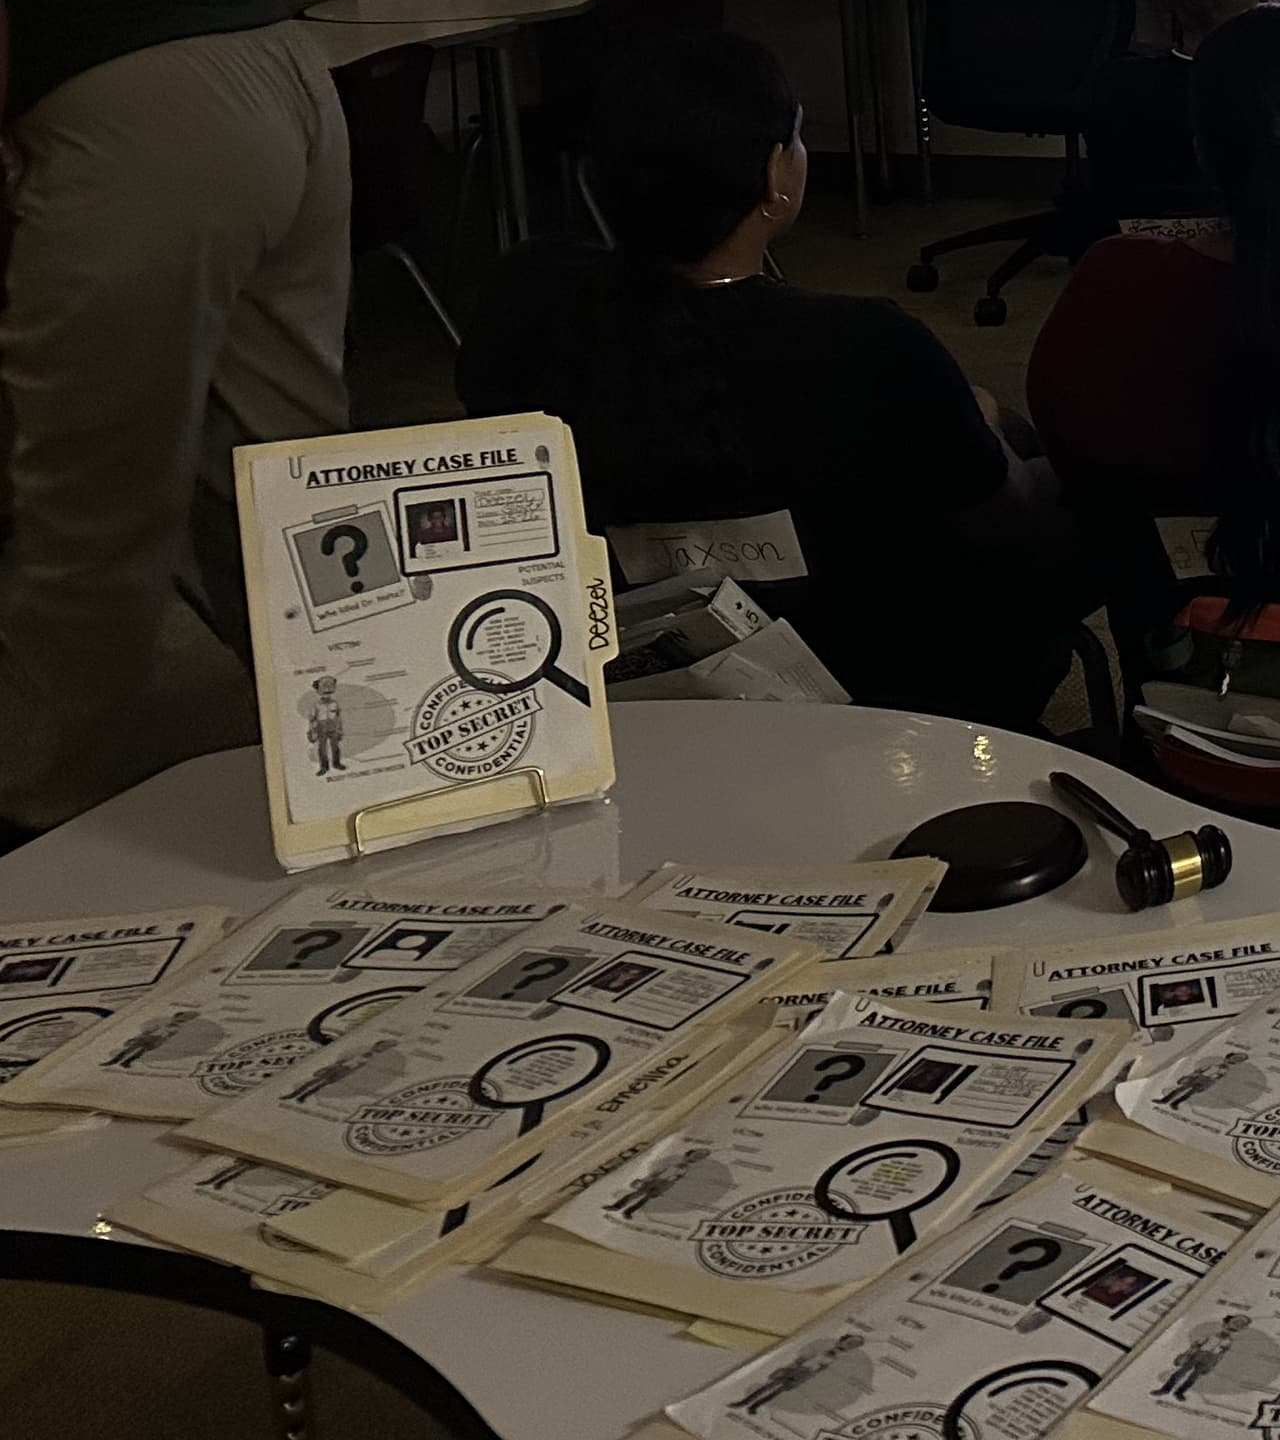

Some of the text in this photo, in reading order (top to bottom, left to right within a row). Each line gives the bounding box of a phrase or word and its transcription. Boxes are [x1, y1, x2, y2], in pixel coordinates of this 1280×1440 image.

[307, 449, 518, 486] ATTORNEY CASE FILE
[647, 536, 784, 569] Jaxson
[412, 696, 534, 756] TOP SECRET
[434, 720, 528, 775] CONFIDENTIAL
[1047, 941, 1272, 981] ATTORNEY CASE FILE
[704, 1222, 854, 1241] TOP SECRET
